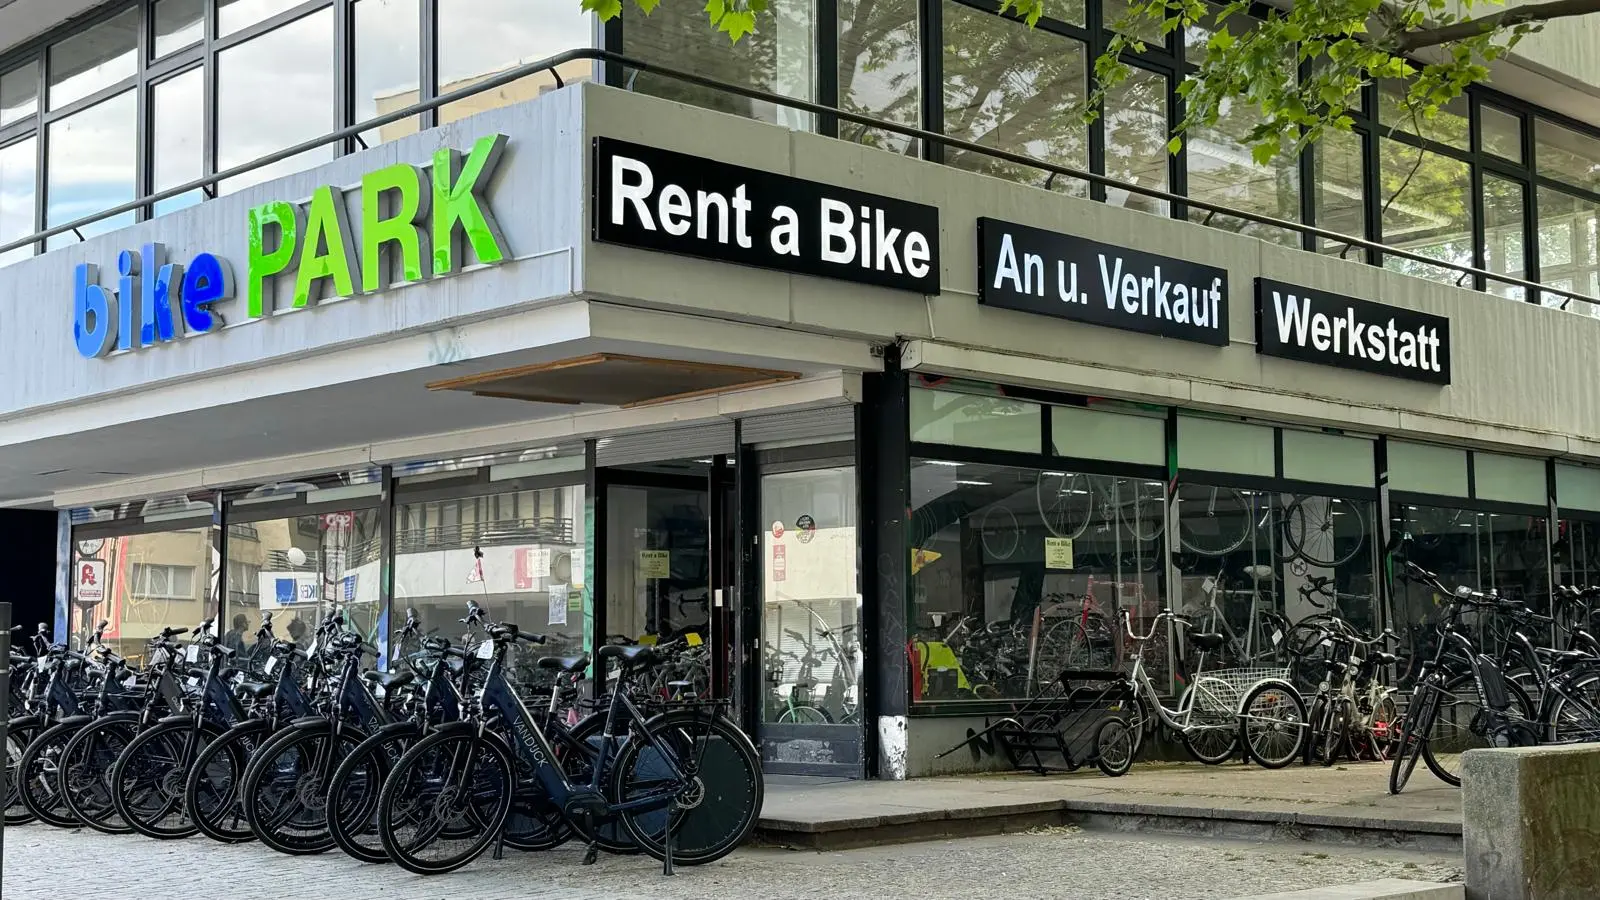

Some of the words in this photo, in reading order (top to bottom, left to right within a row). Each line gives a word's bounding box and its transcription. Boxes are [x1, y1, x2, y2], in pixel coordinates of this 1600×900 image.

[73, 241, 232, 359] bike
[247, 133, 511, 319] PARK
[611, 154, 752, 249] Rent
[770, 205, 800, 256] a
[820, 197, 931, 279] Bike
[992, 233, 1045, 297] An
[1057, 259, 1088, 305] u.
[1098, 253, 1221, 329] Verkauf
[1271, 291, 1441, 373] Werkstatt
